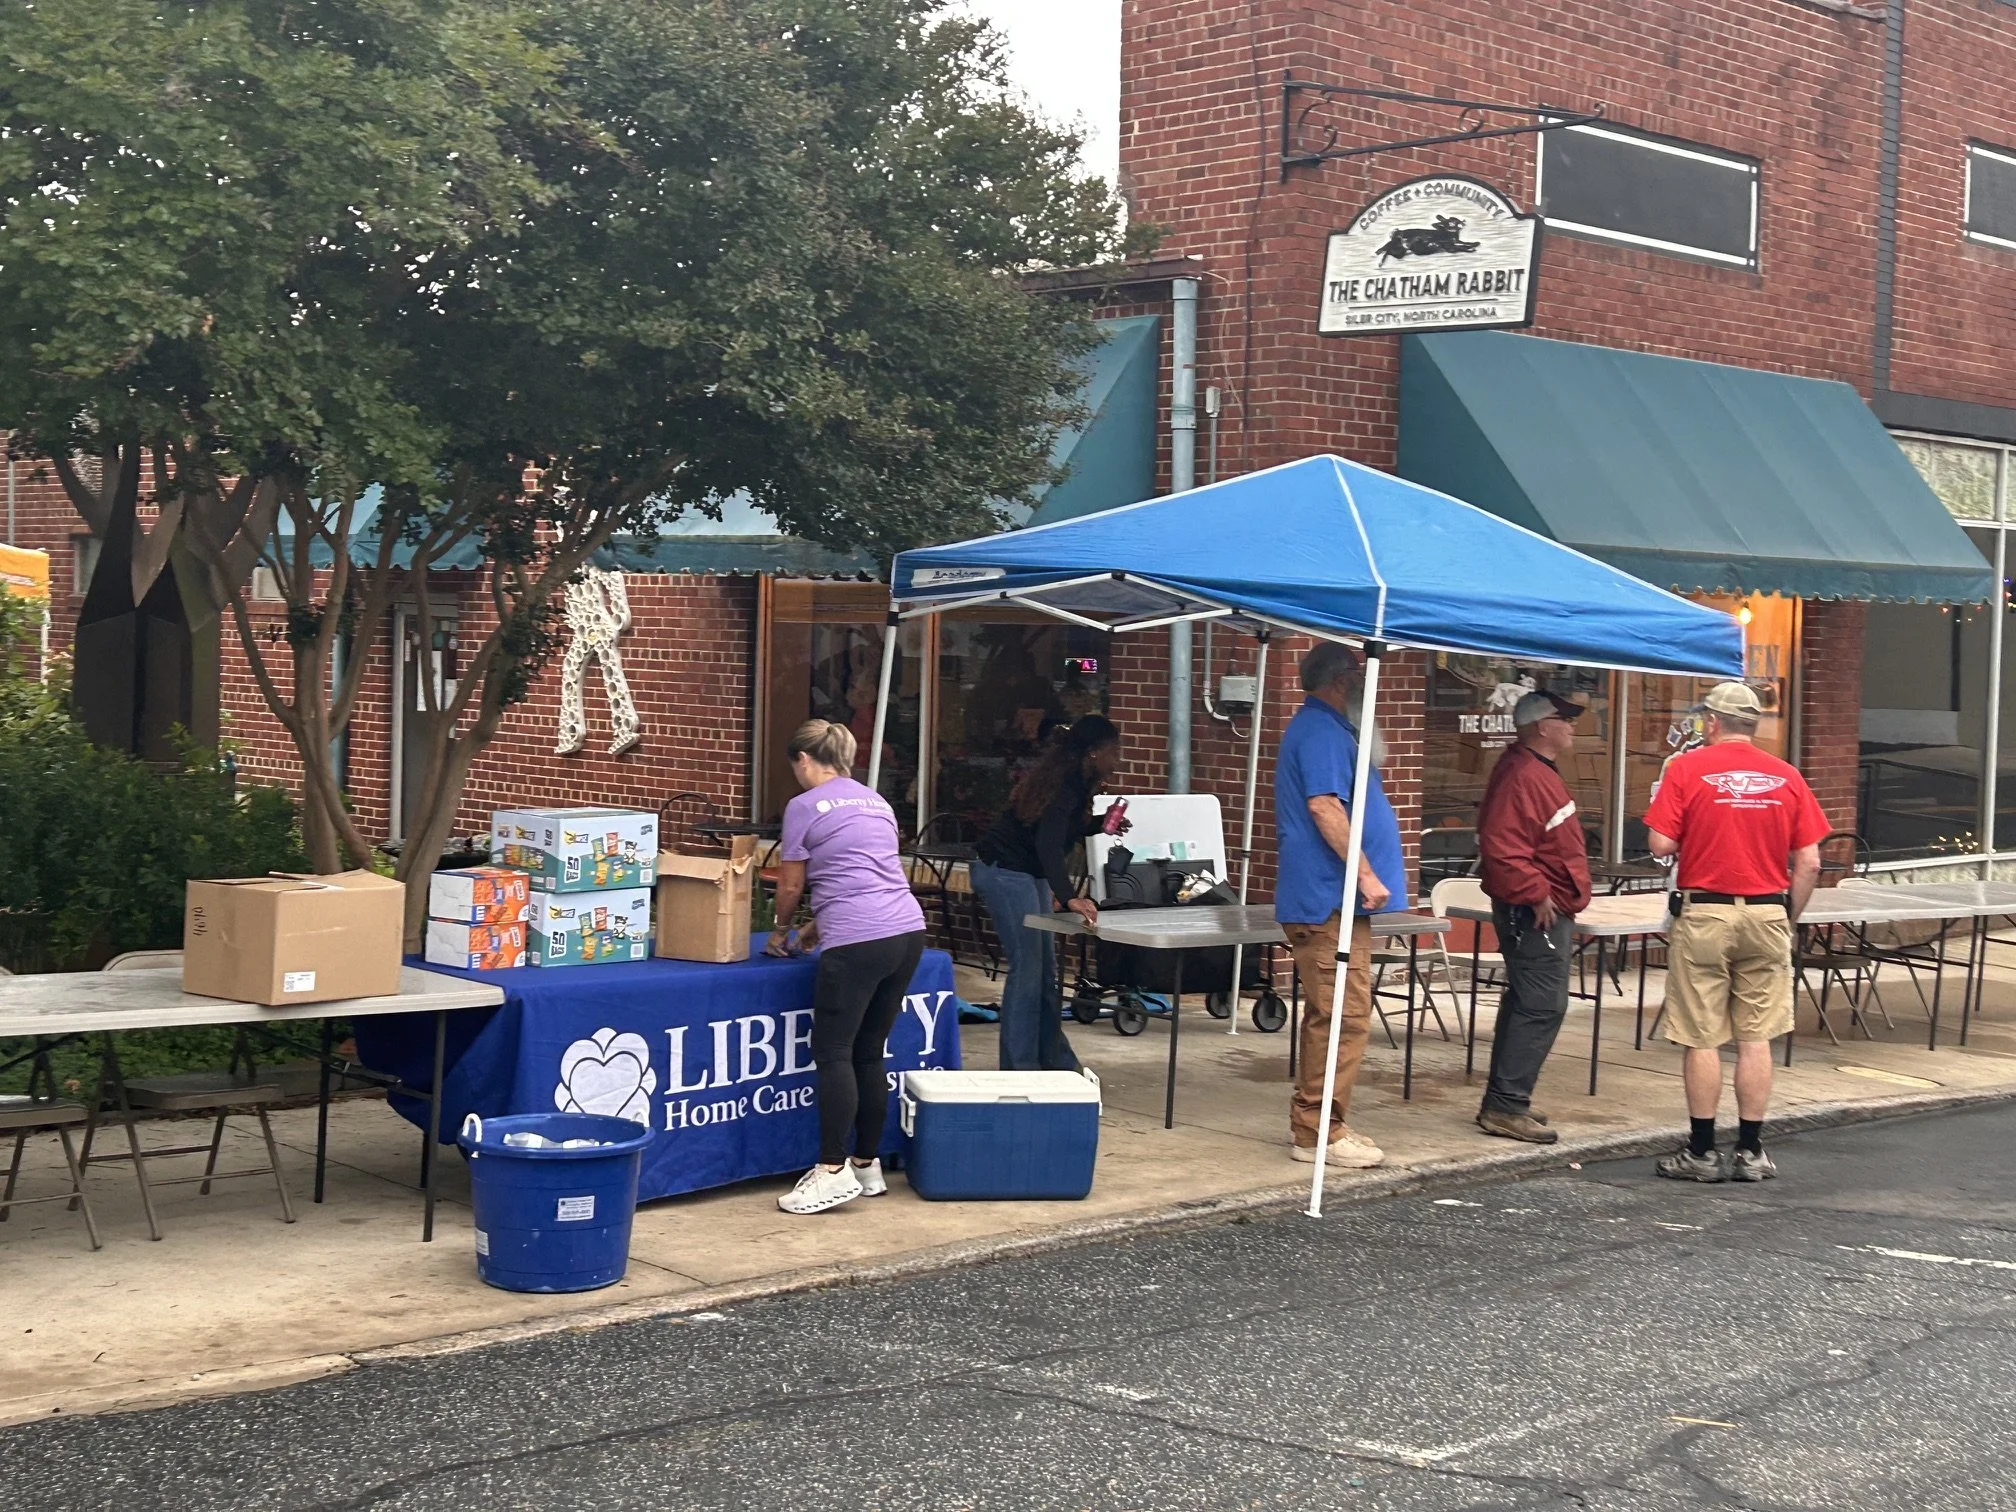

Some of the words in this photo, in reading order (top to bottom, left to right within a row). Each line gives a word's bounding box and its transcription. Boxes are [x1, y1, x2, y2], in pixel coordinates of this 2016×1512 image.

[1359, 188, 1412, 231] COFFEE
[1423, 182, 1506, 217] COMMUNITY
[1329, 279, 1359, 303] THE
[1365, 273, 1450, 300] CHATHAM
[1456, 268, 1525, 295] RABBIT
[1403, 310, 1440, 321] NORTH
[1442, 306, 1498, 319] CAROLINA
[1748, 644, 1780, 682] EN
[1458, 714, 1480, 734] THE
[567, 856, 579, 871] 50
[552, 931, 565, 946] 50
[664, 990, 954, 1095] LIBEY
[664, 1095, 748, 1132] Home
[752, 1084, 815, 1115] Care
